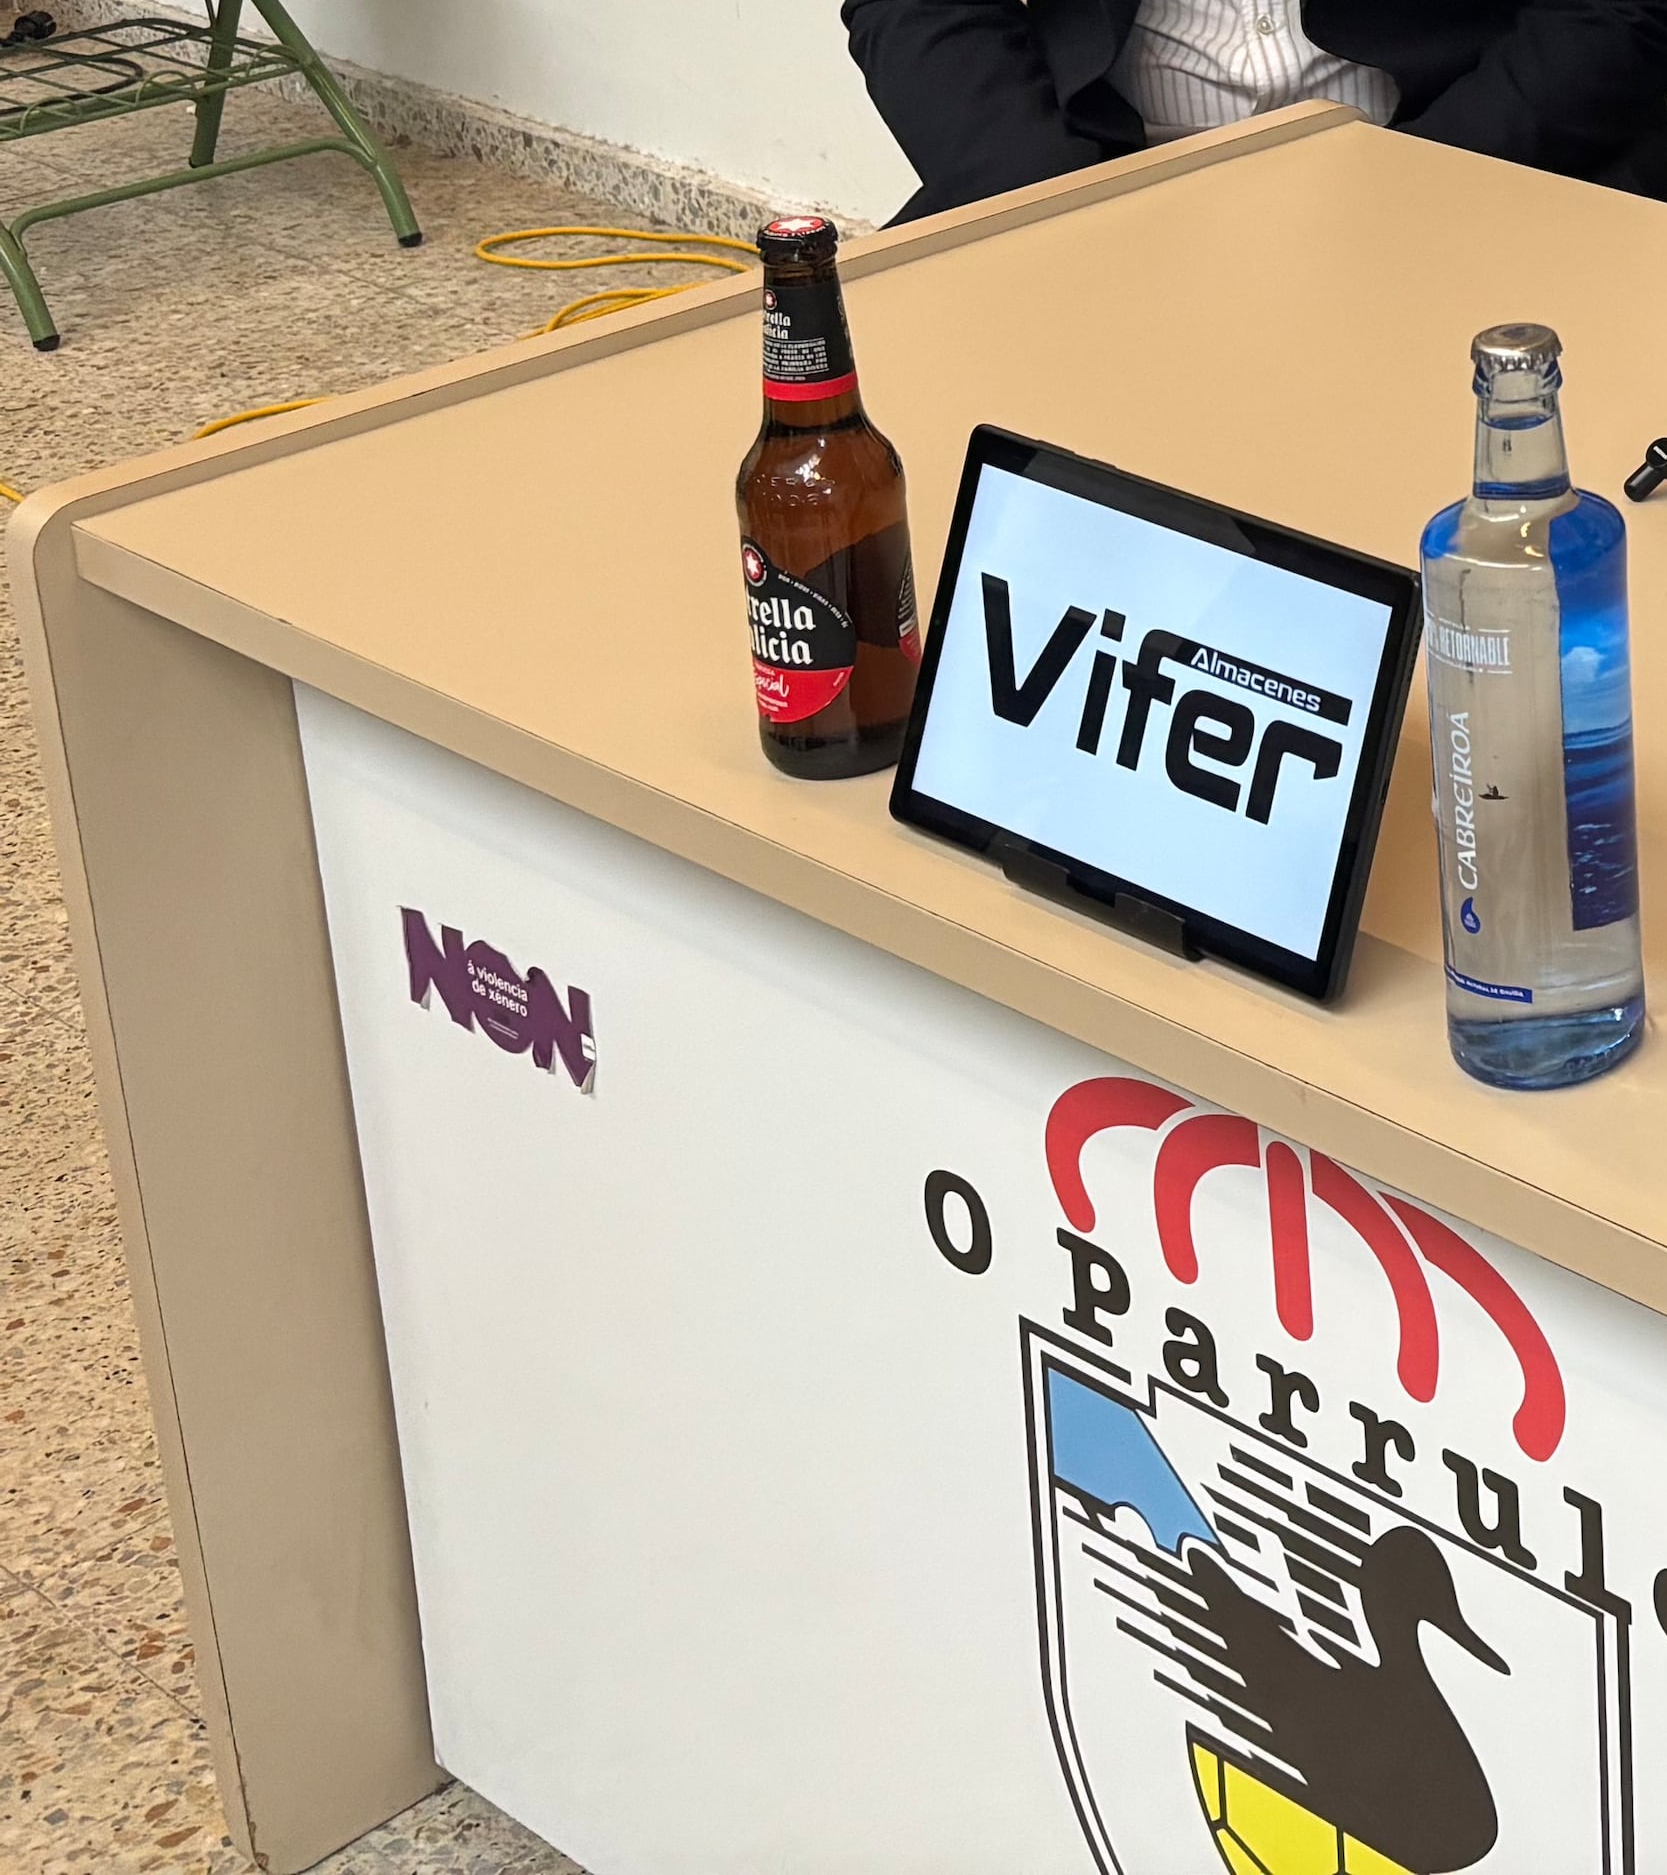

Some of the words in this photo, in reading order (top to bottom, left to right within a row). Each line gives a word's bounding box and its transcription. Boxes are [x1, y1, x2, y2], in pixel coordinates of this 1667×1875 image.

[981, 572, 1342, 825] Vifer
[1190, 649, 1320, 713] Almacenes
[1447, 712, 1478, 890] CABREIROÁ
[467, 960, 475, 975] á
[477, 967, 528, 1002] violencia
[472, 979, 486, 997] de
[489, 987, 527, 1016] xénero
[925, 1170, 992, 1275] O
